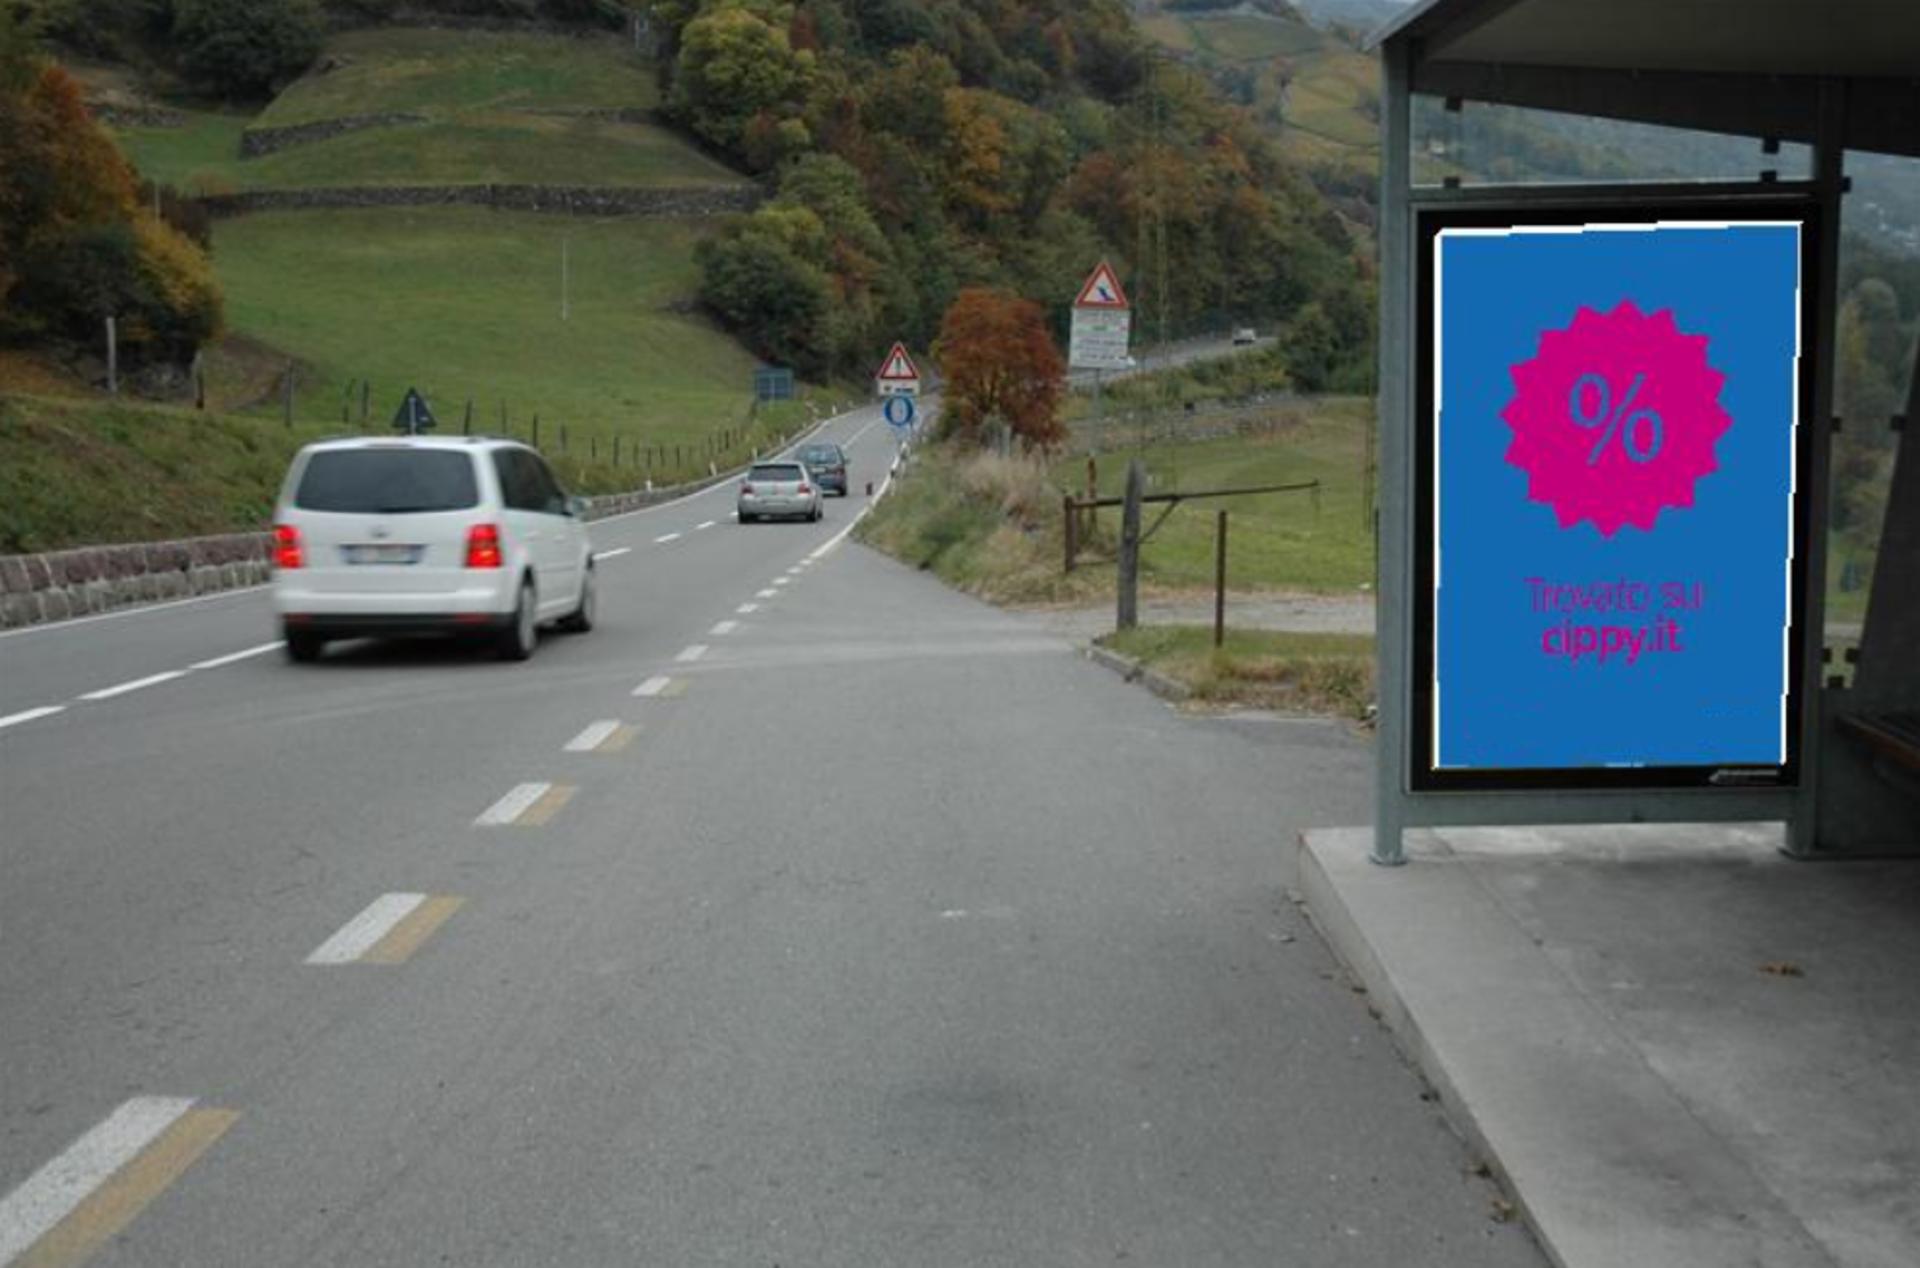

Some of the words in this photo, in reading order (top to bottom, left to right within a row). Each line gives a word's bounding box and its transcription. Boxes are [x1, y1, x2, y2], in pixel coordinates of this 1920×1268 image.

[1569, 371, 1663, 466] %
[1524, 576, 1650, 613] Trovato
[1660, 580, 1703, 610] su
